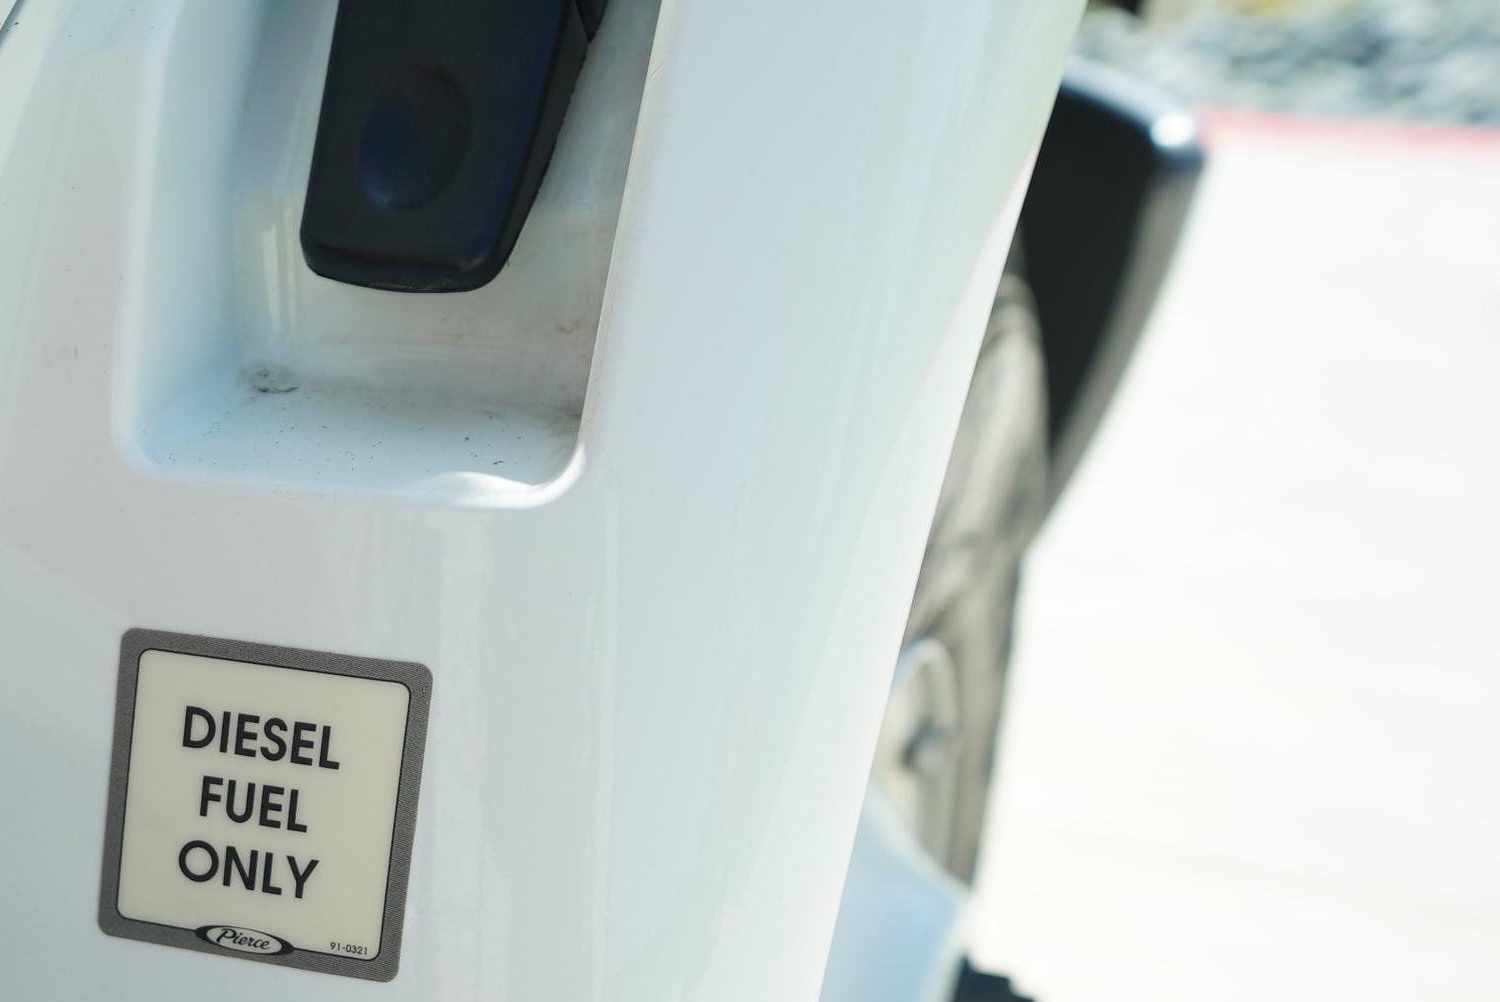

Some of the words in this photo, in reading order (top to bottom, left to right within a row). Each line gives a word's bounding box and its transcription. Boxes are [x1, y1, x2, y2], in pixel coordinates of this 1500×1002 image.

[182, 705, 340, 770] DIESEL
[199, 775, 308, 833] FUEL
[178, 840, 319, 899] ONLY
[216, 928, 271, 950] Pierce
[329, 941, 368, 956] 91-0321
